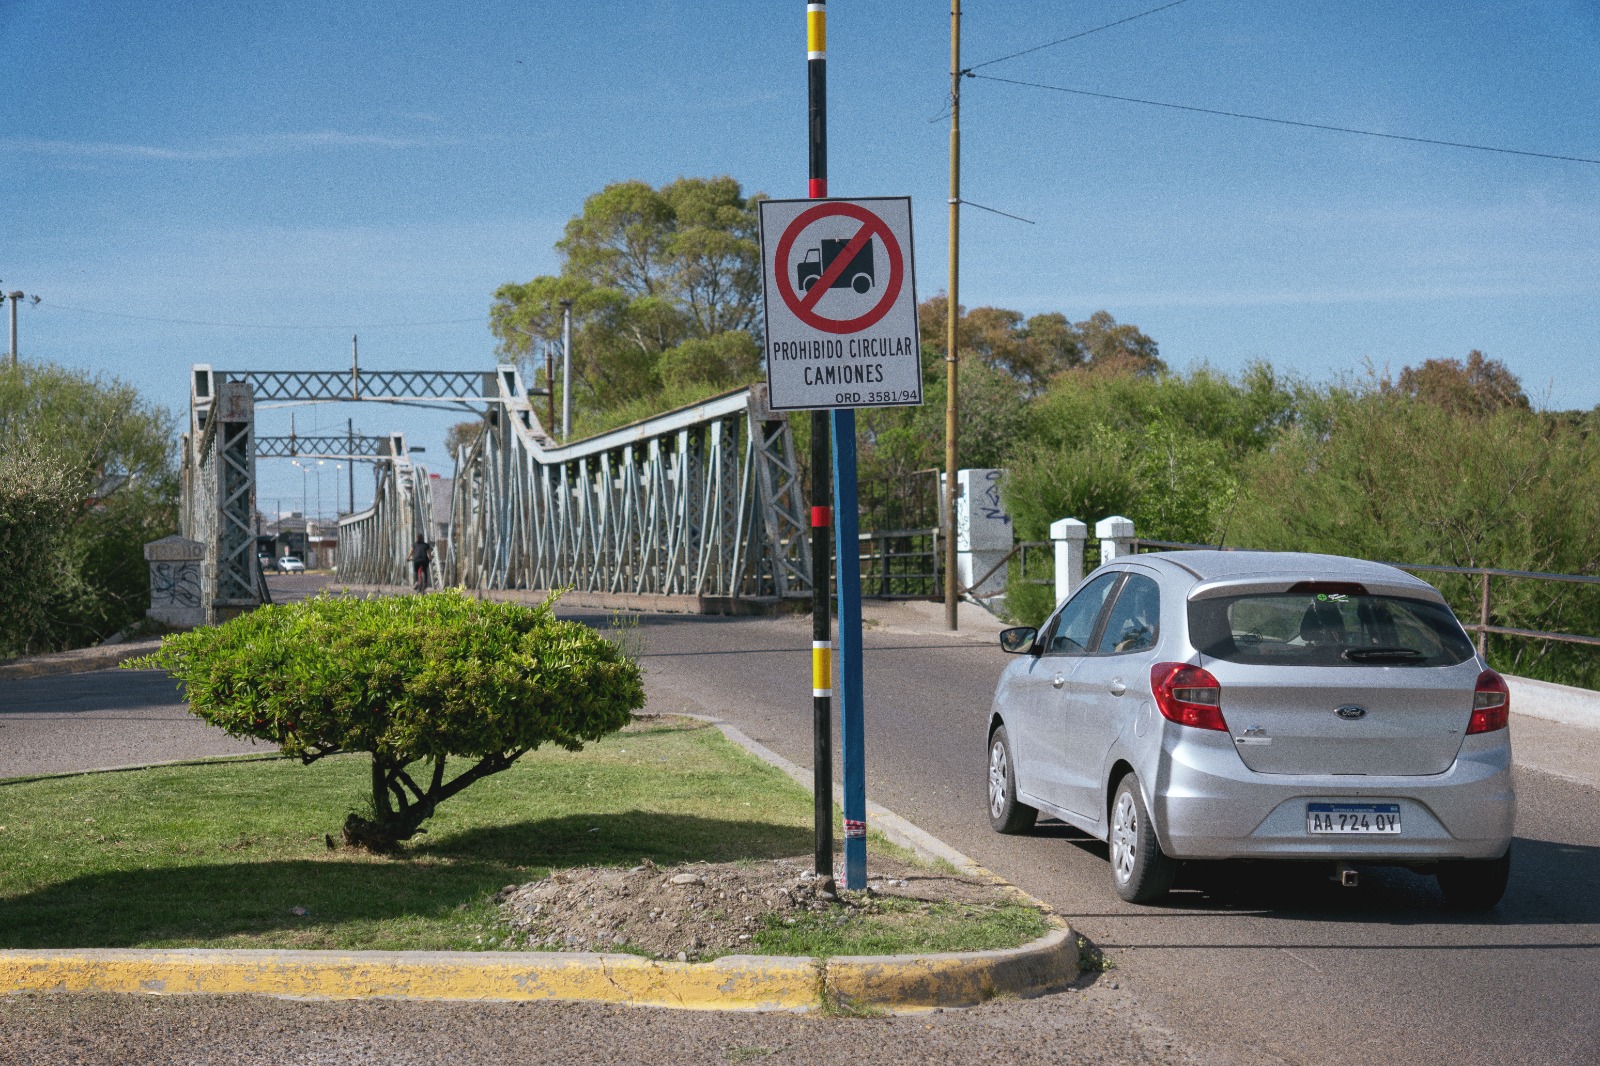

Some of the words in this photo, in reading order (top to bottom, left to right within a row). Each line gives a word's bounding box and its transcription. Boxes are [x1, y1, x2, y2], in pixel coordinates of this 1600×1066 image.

[774, 340, 843, 361] PROHIBIDO
[849, 337, 912, 358] CIRCULAR
[804, 363, 884, 386] CAMIONES
[1313, 813, 1334, 831] AA
[1338, 814, 1370, 831] 724
